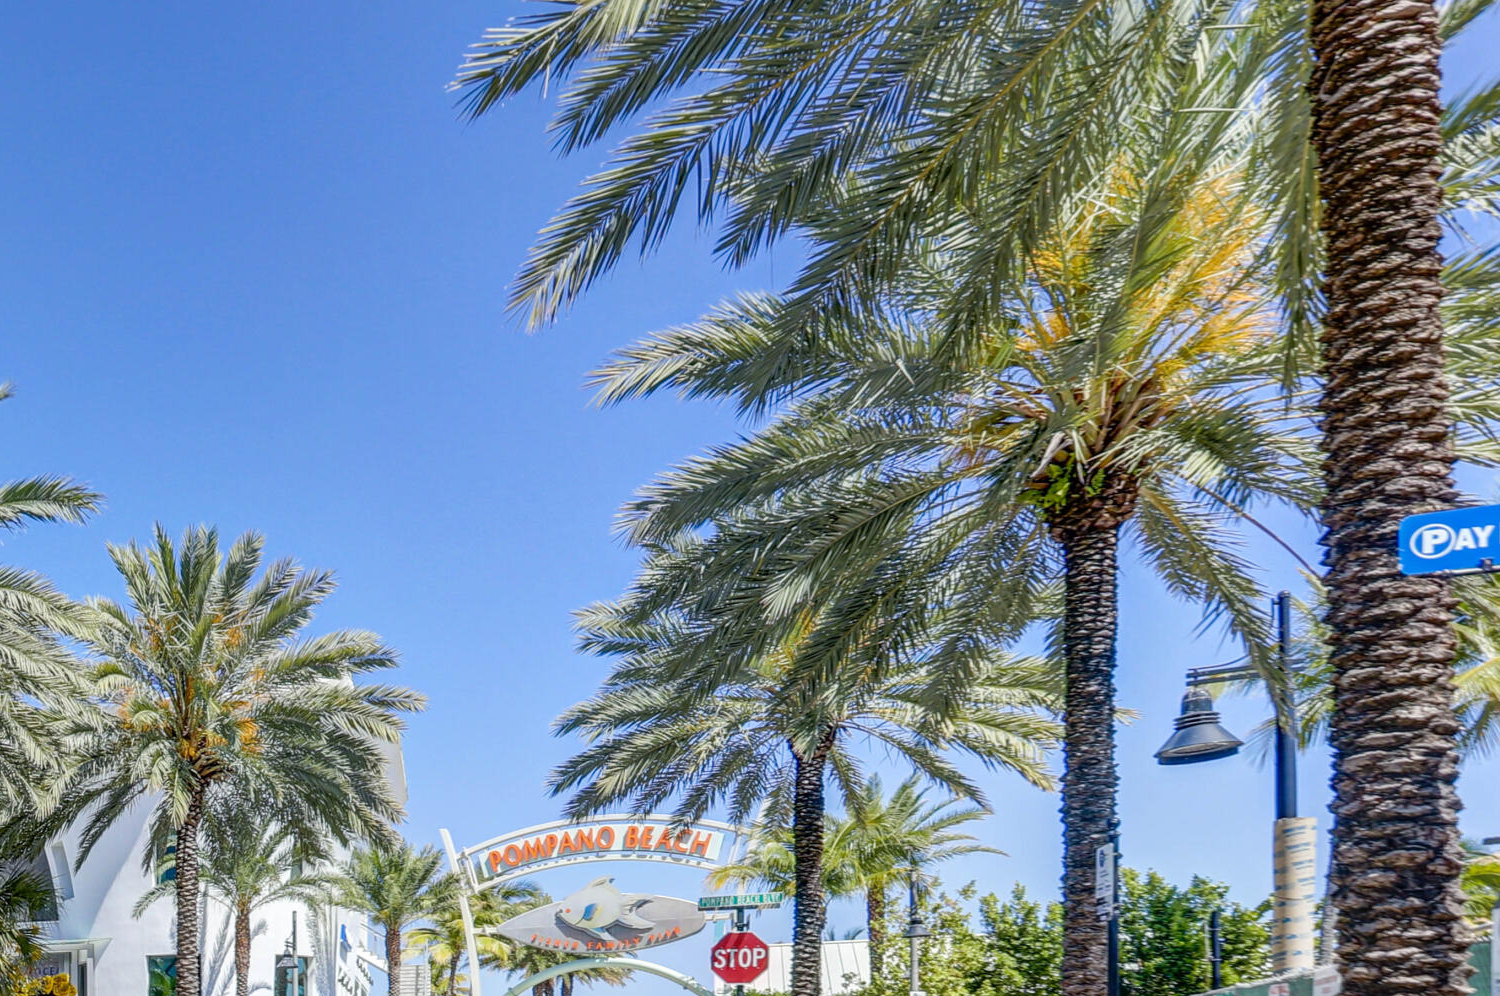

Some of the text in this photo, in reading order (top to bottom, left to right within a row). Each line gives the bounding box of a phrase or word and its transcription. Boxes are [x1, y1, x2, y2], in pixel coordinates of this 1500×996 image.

[1416, 524, 1496, 556] PAY
[488, 825, 713, 873] POMPANO BEACH
[702, 896, 734, 907] POMPANO
[739, 894, 760, 905] BEACH
[531, 925, 682, 951] FISHER FAMILY PIER
[713, 947, 767, 969] STOP
